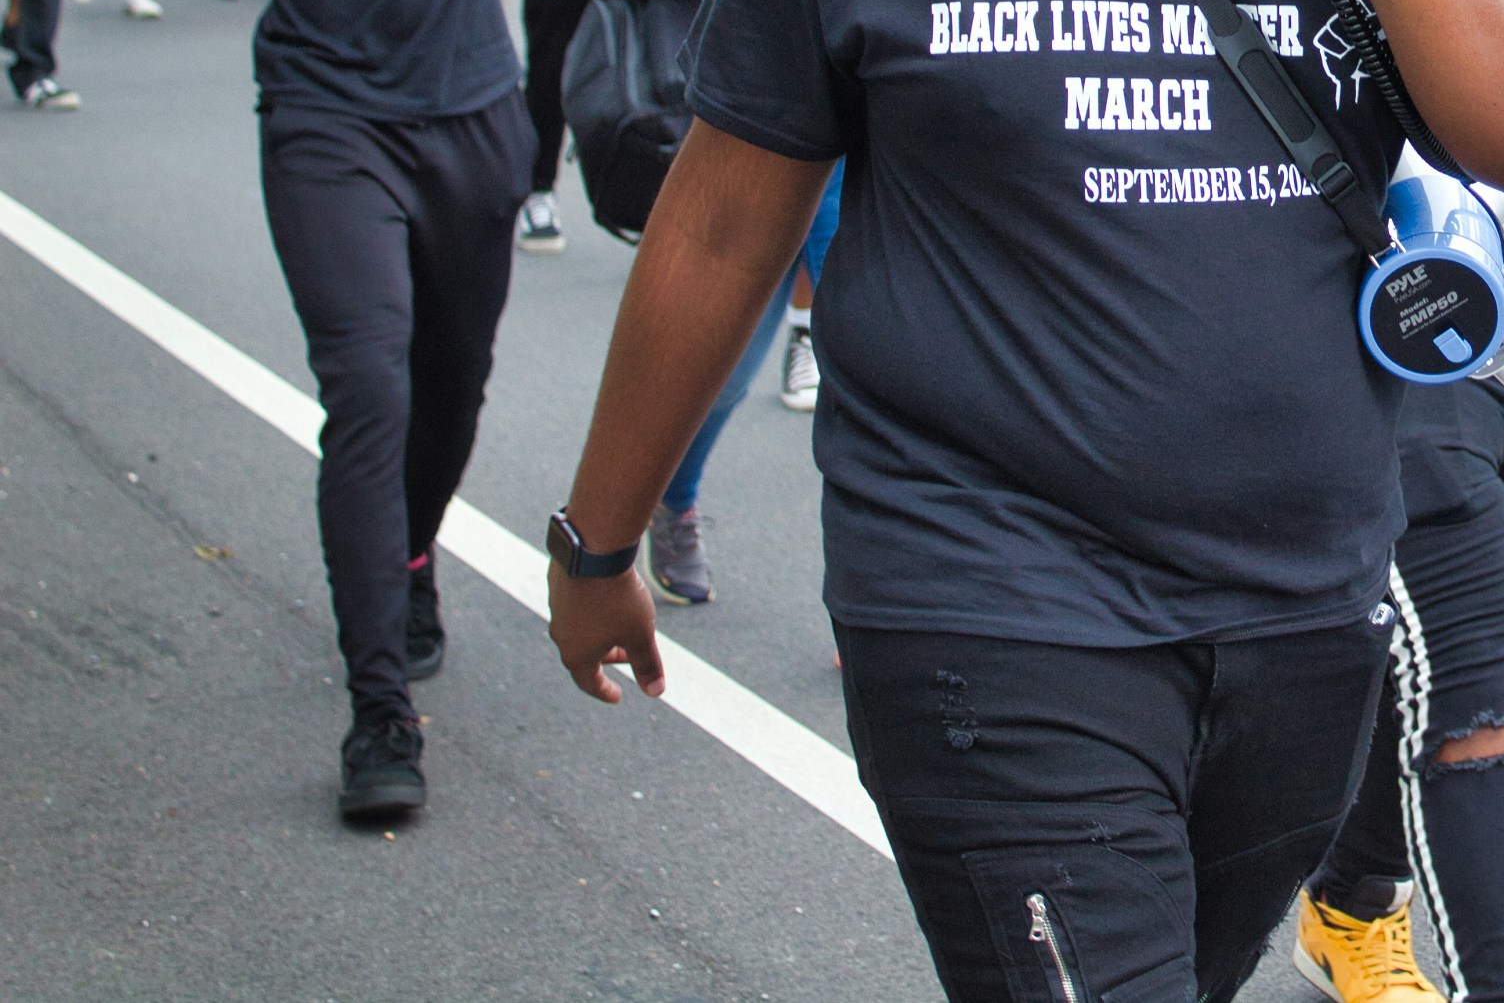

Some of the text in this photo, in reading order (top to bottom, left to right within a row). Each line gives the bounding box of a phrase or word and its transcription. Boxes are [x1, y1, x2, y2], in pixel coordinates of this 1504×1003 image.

[929, 1, 1040, 55] BLACK
[1051, 0, 1151, 53] LIVES
[1065, 77, 1212, 131] MARCH
[1084, 166, 1245, 204] SEPTEMBER
[1399, 291, 1458, 333] PMP50
[1400, 297, 1429, 318] Model:
